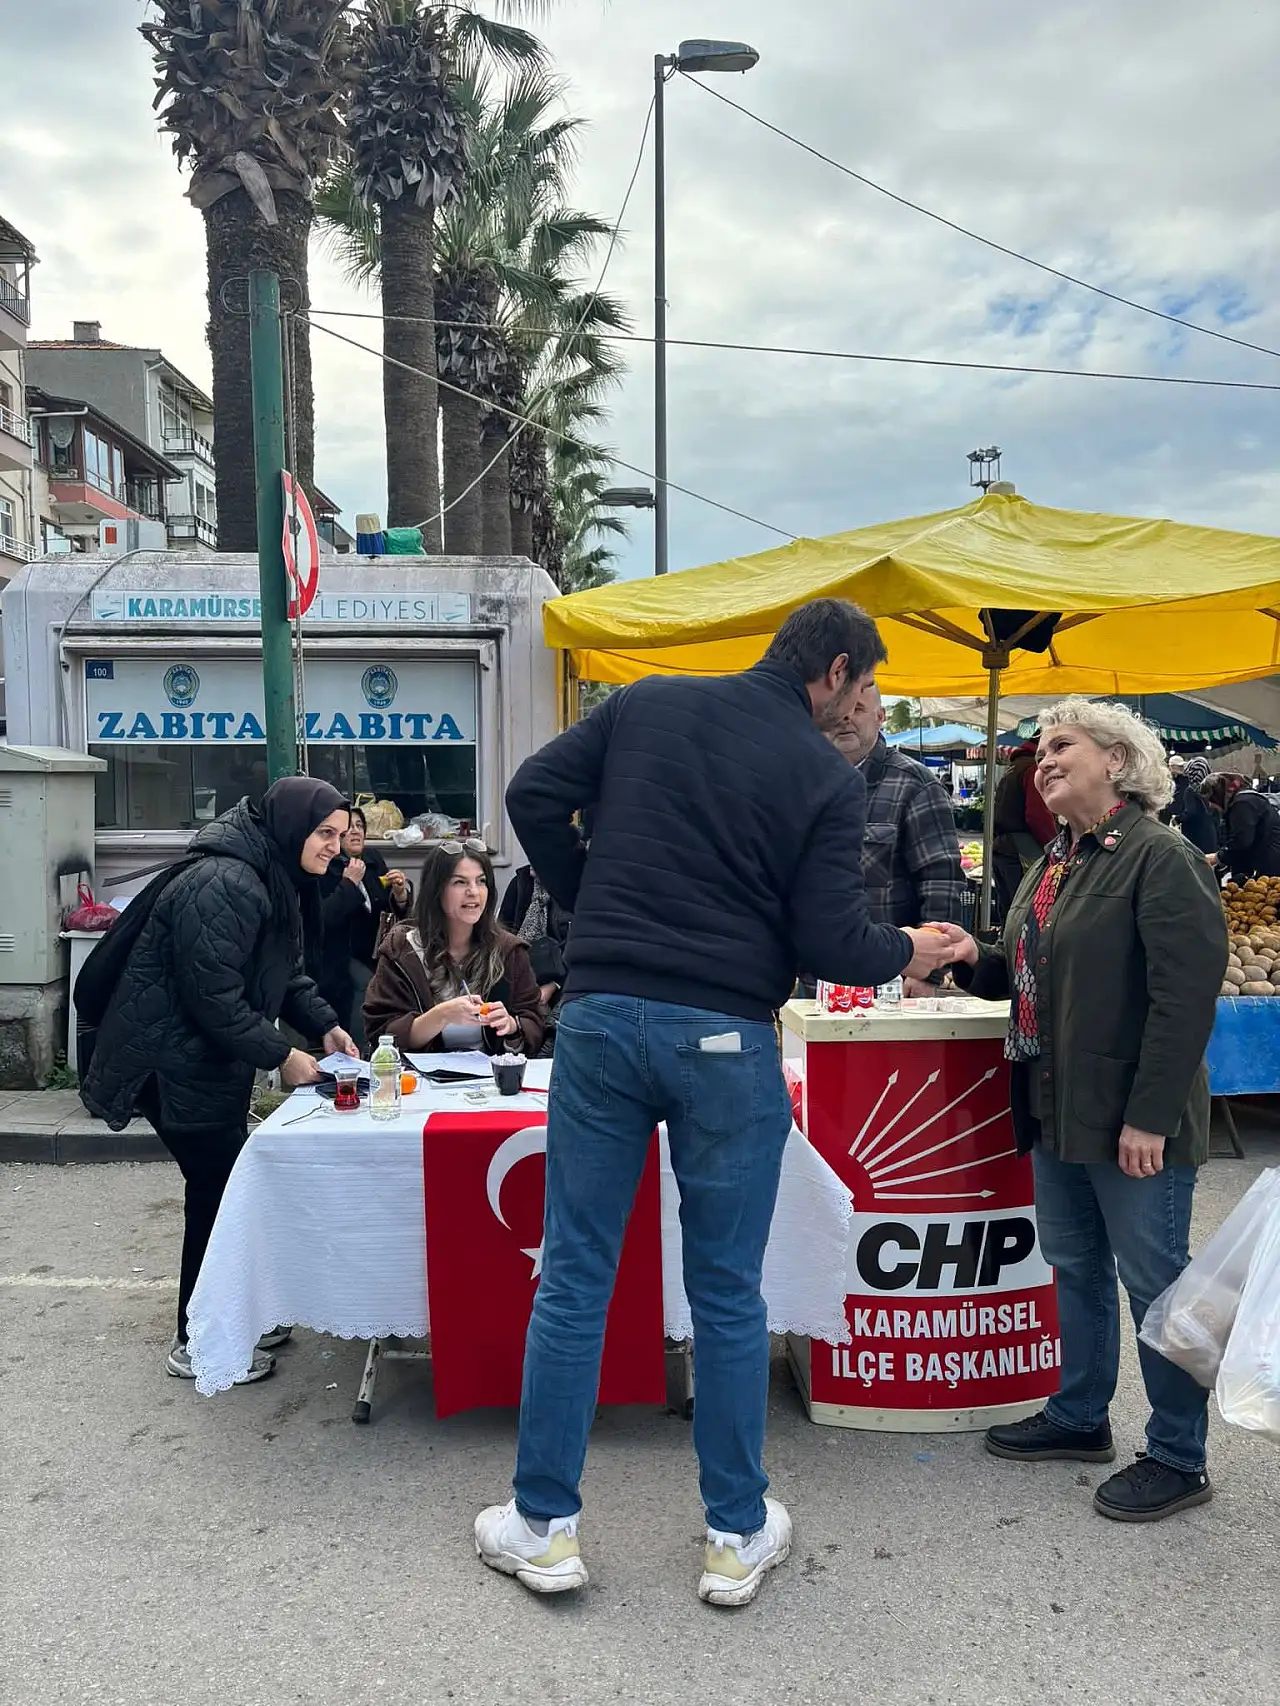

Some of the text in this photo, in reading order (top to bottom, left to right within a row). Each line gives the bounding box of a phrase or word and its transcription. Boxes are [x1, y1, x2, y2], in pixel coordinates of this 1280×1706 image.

[129, 594, 435, 620] KARAMÜRSE ELEDİYESİ
[93, 667, 107, 677] 100
[98, 712, 267, 739] ZABITA
[304, 712, 465, 740] ZABITA
[856, 1216, 1036, 1291] CHP
[853, 1301, 1042, 1339] KARAMÜRSEL
[831, 1333, 1062, 1389] İLÇE BAŞKANLIĞI
